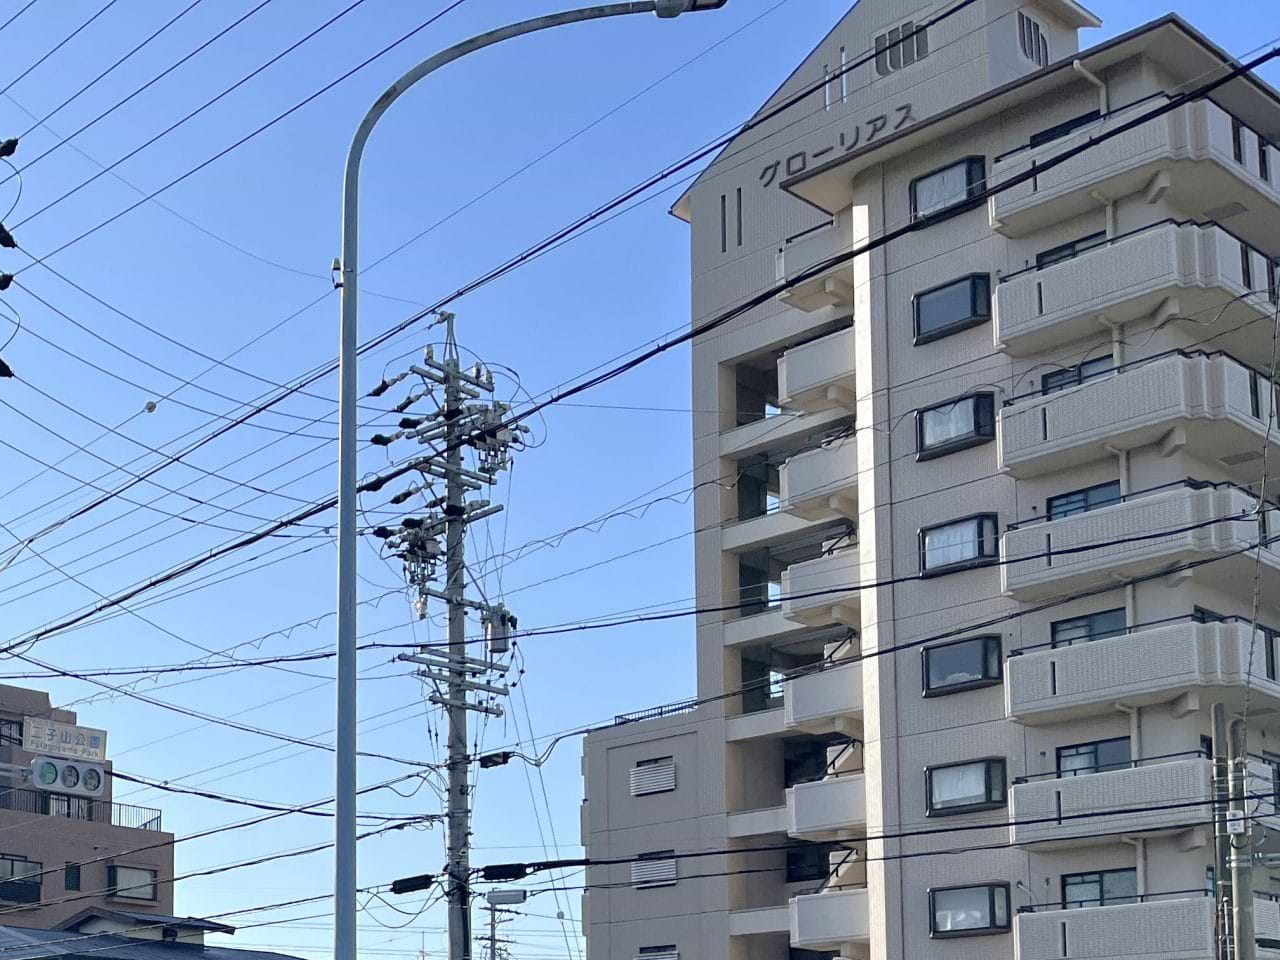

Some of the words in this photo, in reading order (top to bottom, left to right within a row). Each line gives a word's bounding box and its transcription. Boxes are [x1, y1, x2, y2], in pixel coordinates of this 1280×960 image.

[759, 103, 917, 188] グローリアス
